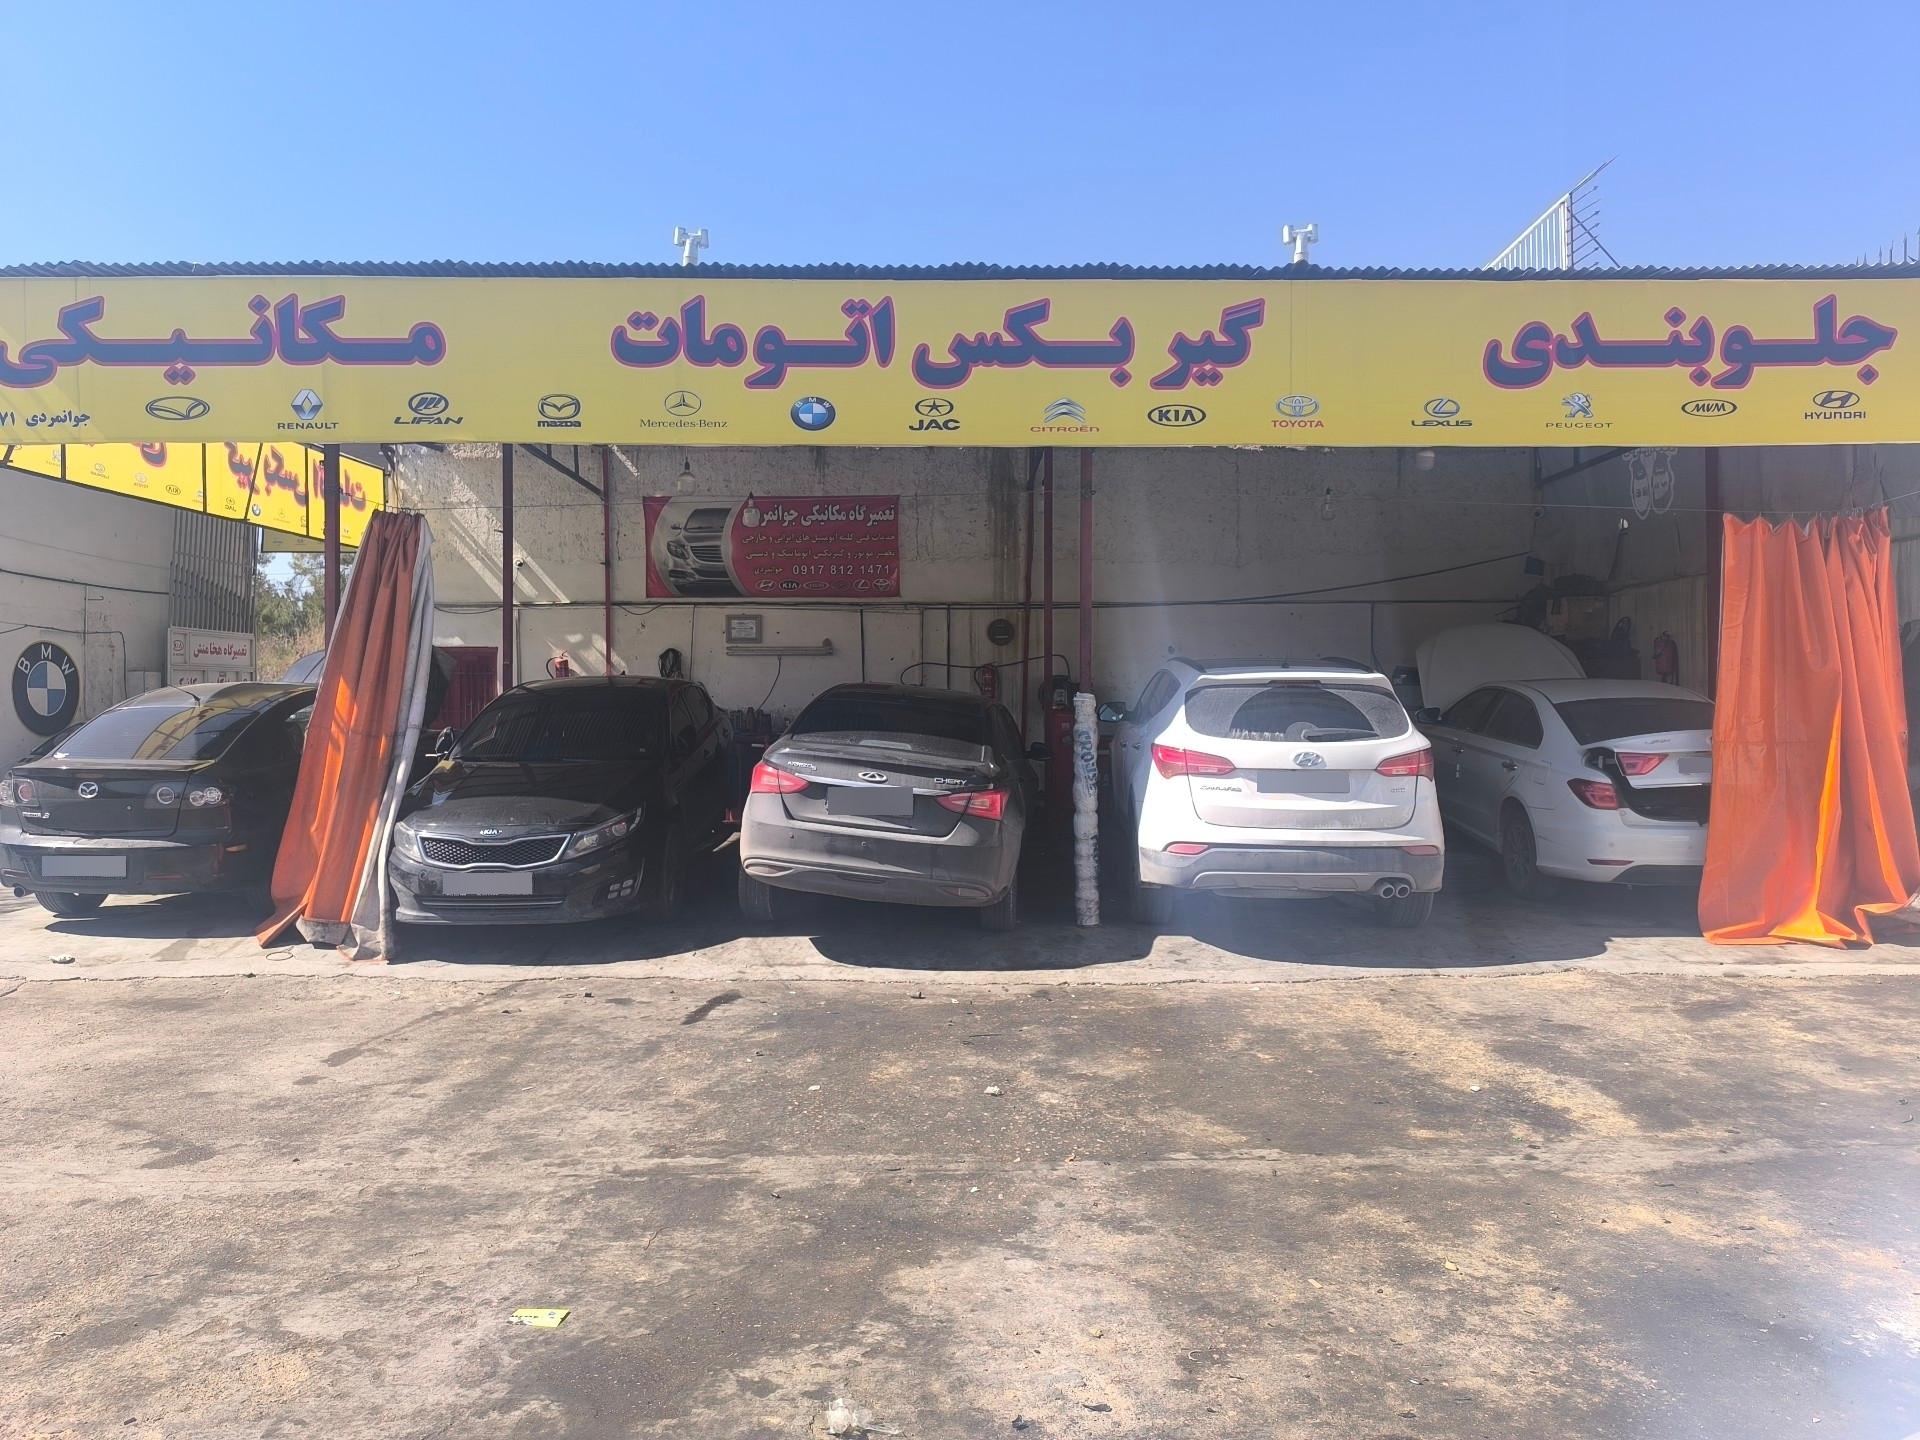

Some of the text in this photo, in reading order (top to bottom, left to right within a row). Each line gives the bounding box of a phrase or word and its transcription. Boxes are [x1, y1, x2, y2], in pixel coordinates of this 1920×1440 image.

[0, 293, 447, 389] مکانیکی
[610, 294, 1265, 391] گیر بکس اتومات
[1483, 293, 1898, 389] جلوبندی
[1694, 402, 1726, 414] MVM
[26, 409, 91, 428] جوانمردی
[1157, 408, 1196, 422] KIA
[1804, 410, 1867, 419] HYUNDAI
[277, 421, 338, 430] RENAULT
[394, 416, 463, 425] LIFAN
[537, 420, 582, 428] mazda
[639, 418, 729, 429] Mercedes-Benz
[908, 418, 960, 430] JAC
[1271, 419, 1324, 428] TOYOTA
[1545, 421, 1613, 429] PEUGEOT
[760, 504, 799, 527] جوانمر
[800, 504, 847, 527] مکانیکی
[792, 564, 824, 575] 0917
[830, 564, 853, 575] 812
[860, 564, 889, 575] 1471
[934, 777, 967, 785] CHERY
